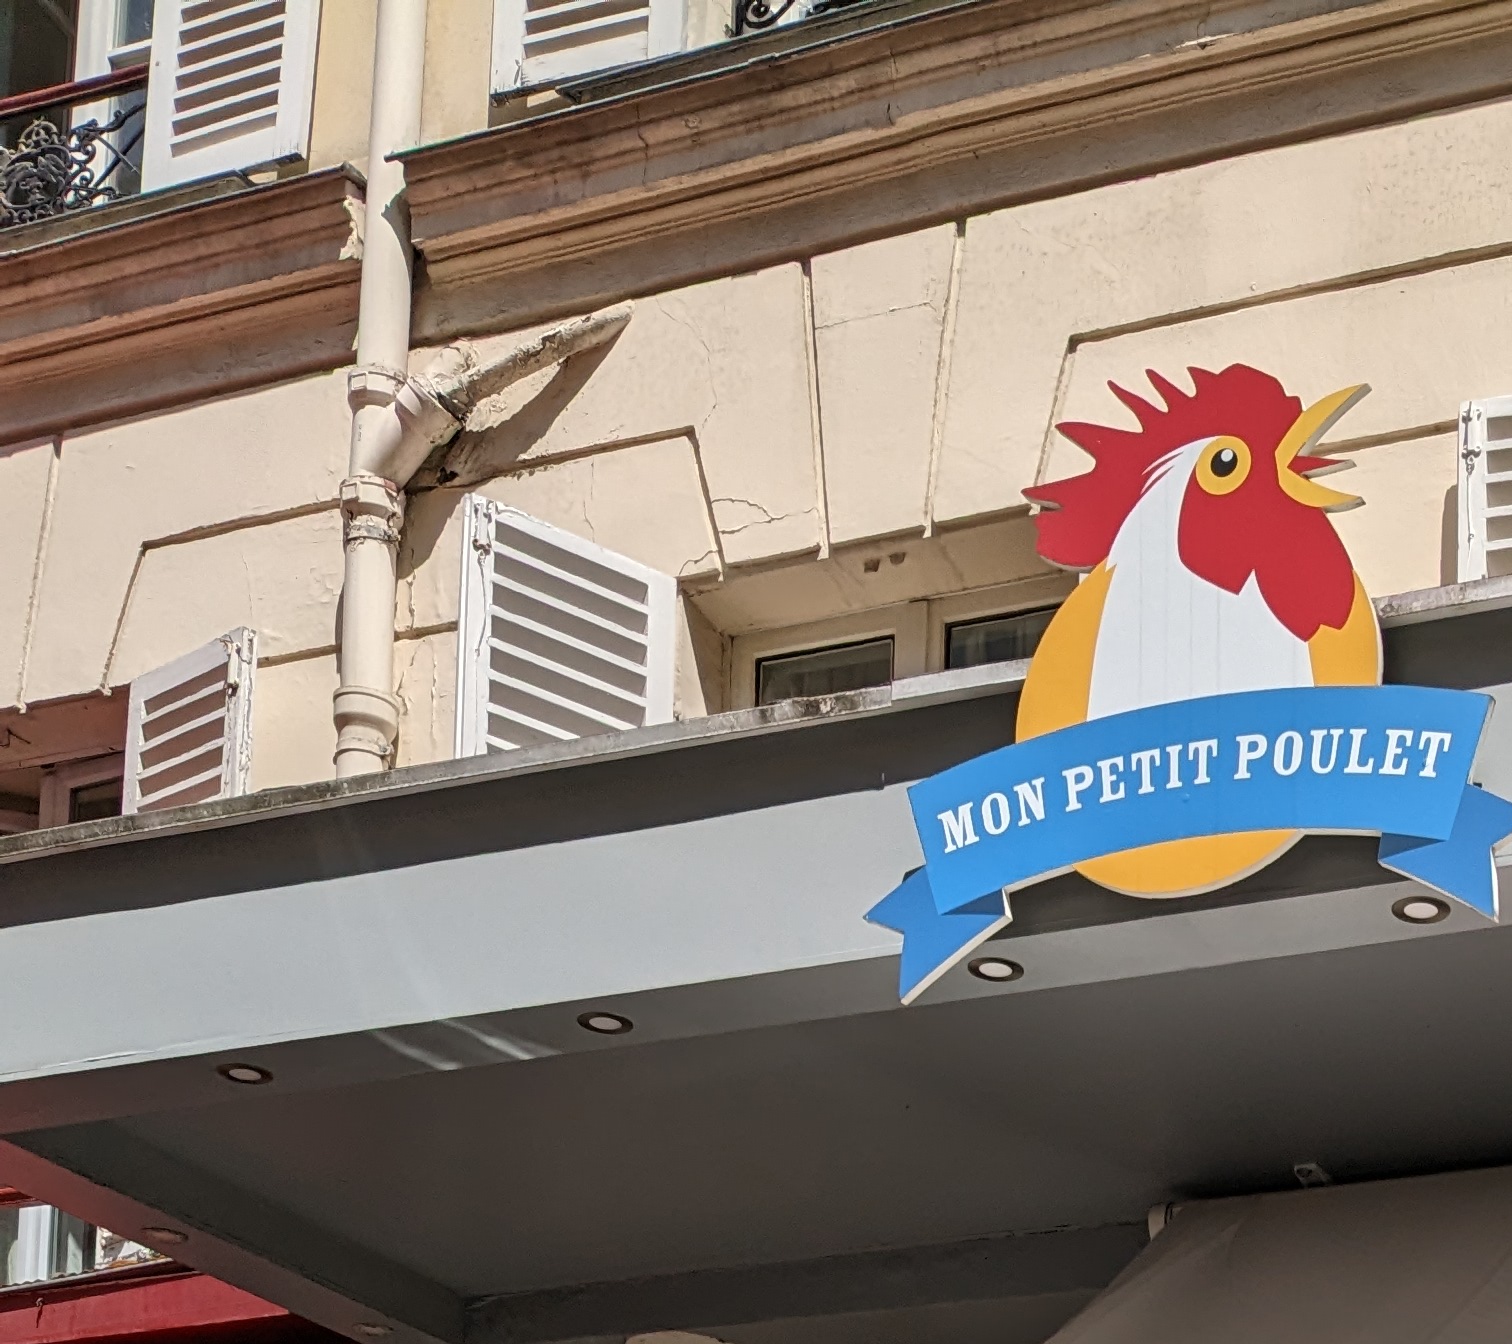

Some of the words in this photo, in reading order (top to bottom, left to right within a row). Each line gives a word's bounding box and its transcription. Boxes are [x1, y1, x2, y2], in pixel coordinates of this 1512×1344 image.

[937, 775, 1048, 854] MON
[1063, 738, 1219, 813] PETIT
[1234, 728, 1452, 781] POULET
